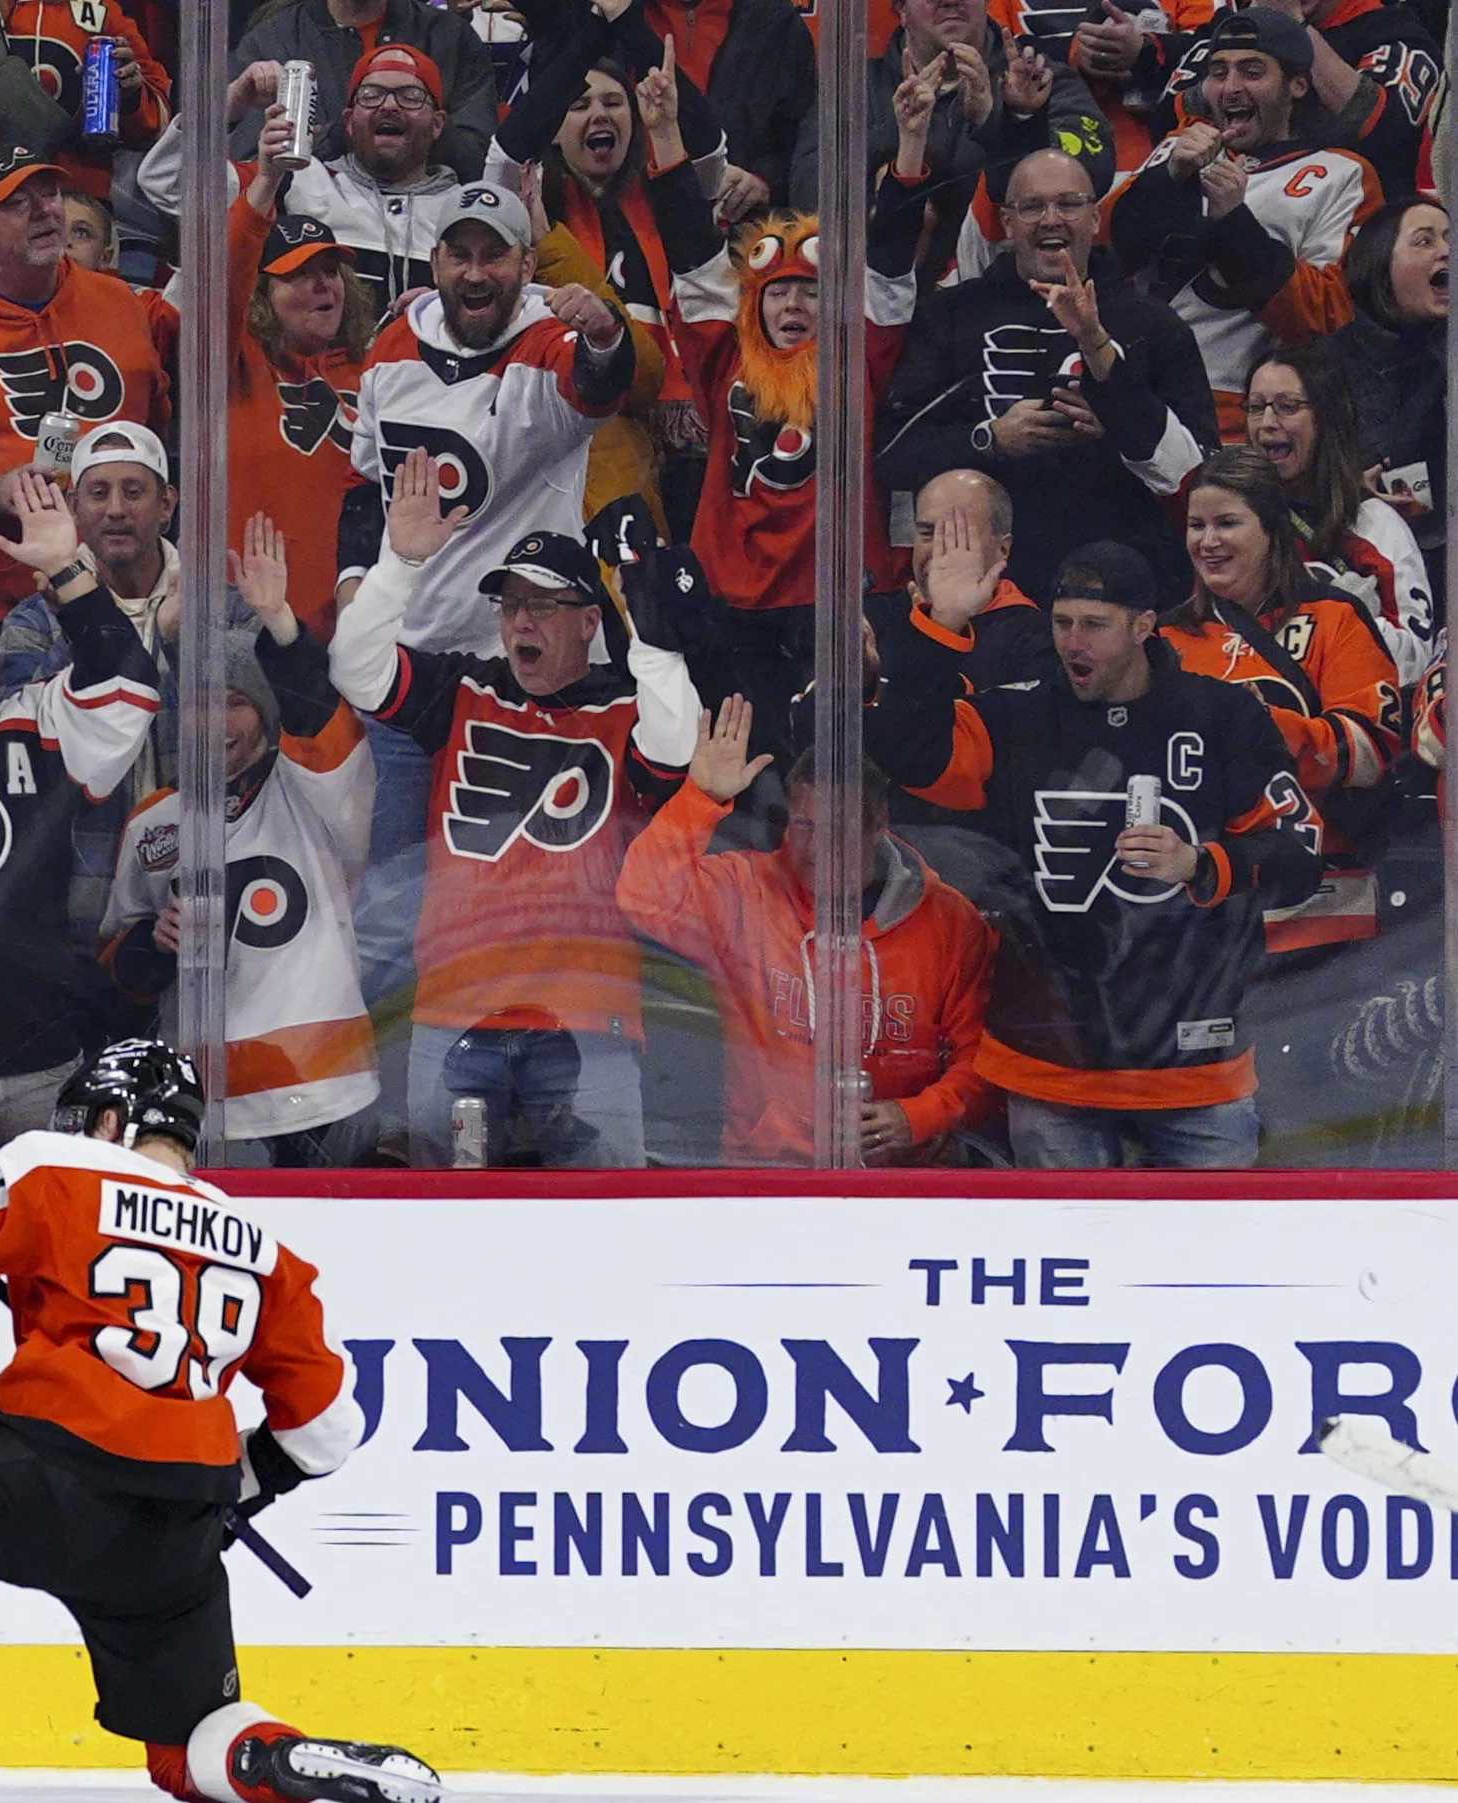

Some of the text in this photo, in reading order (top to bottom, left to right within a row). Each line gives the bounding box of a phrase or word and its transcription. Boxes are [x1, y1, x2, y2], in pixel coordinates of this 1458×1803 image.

[80, 8, 97, 28] A
[85, 63, 101, 119] ULTRA
[306, 85, 320, 137] TRULY
[1284, 165, 1328, 198] C
[7, 742, 38, 795] A
[1167, 731, 1204, 791] C
[769, 967, 916, 1042] FLRS
[114, 1188, 263, 1264] MICHKOV
[909, 1258, 1090, 1306] THE
[88, 1243, 264, 1401] 39
[1001, 1339, 1458, 1455] FOR
[435, 1492, 1458, 1580] PENNSYLVANIA'S VOD
